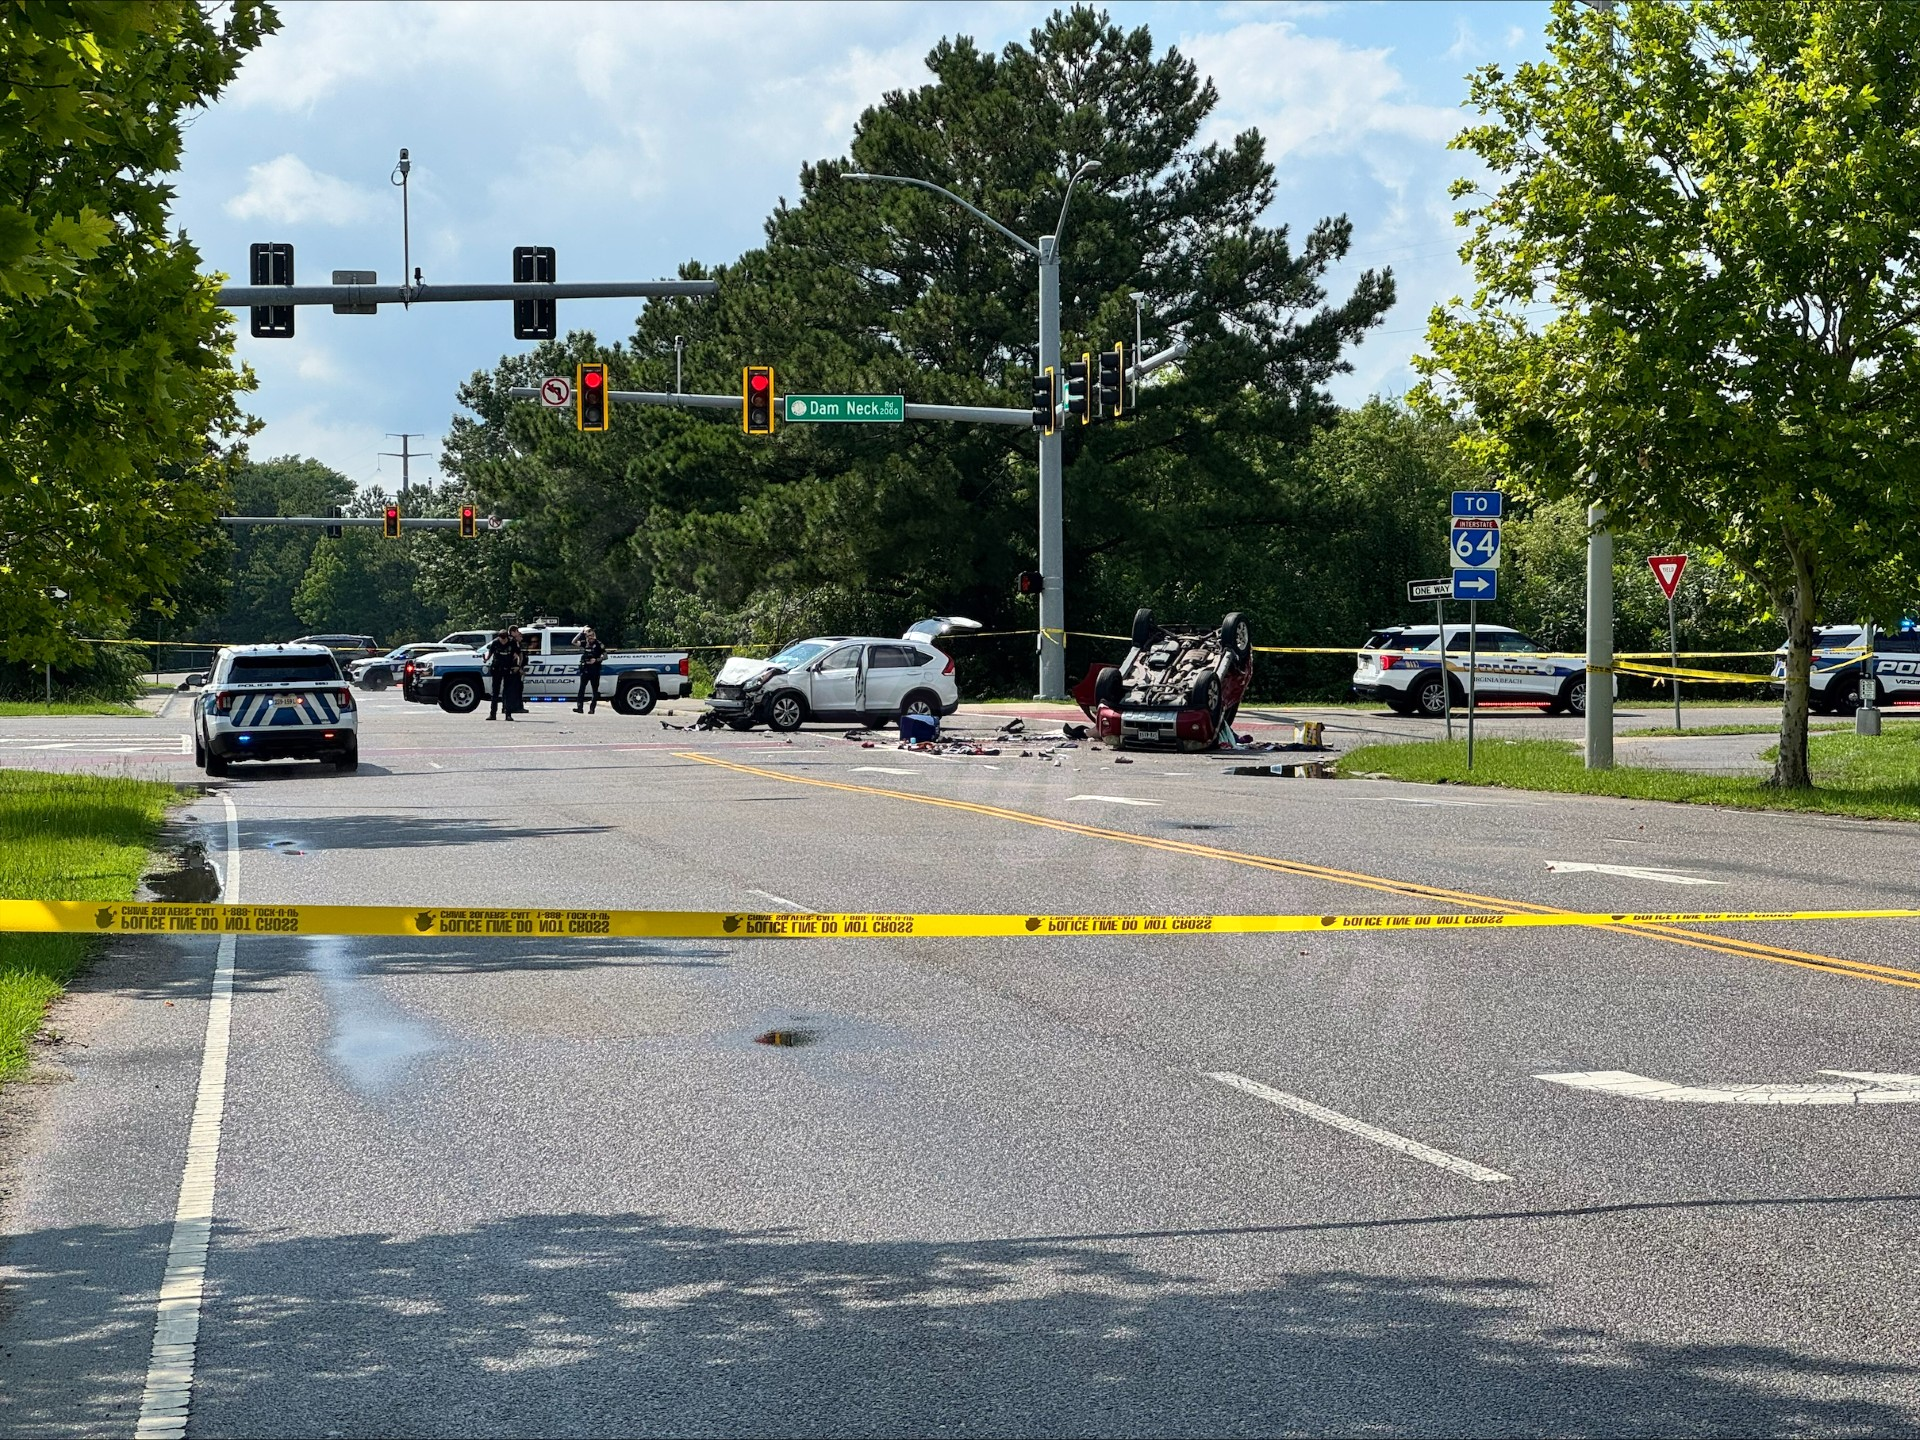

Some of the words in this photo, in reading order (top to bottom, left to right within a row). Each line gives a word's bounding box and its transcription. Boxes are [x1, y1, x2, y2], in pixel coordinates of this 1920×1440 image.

[810, 401, 839, 415] Dam
[846, 401, 880, 415] Neck
[880, 407, 899, 415] 2000
[1464, 497, 1488, 512] TO
[1456, 530, 1495, 558] 64
[1415, 586, 1432, 595] ONE
[1433, 585, 1450, 594] WAY
[523, 665, 579, 675] OLICE
[1474, 676, 1499, 684] IRGINIA
